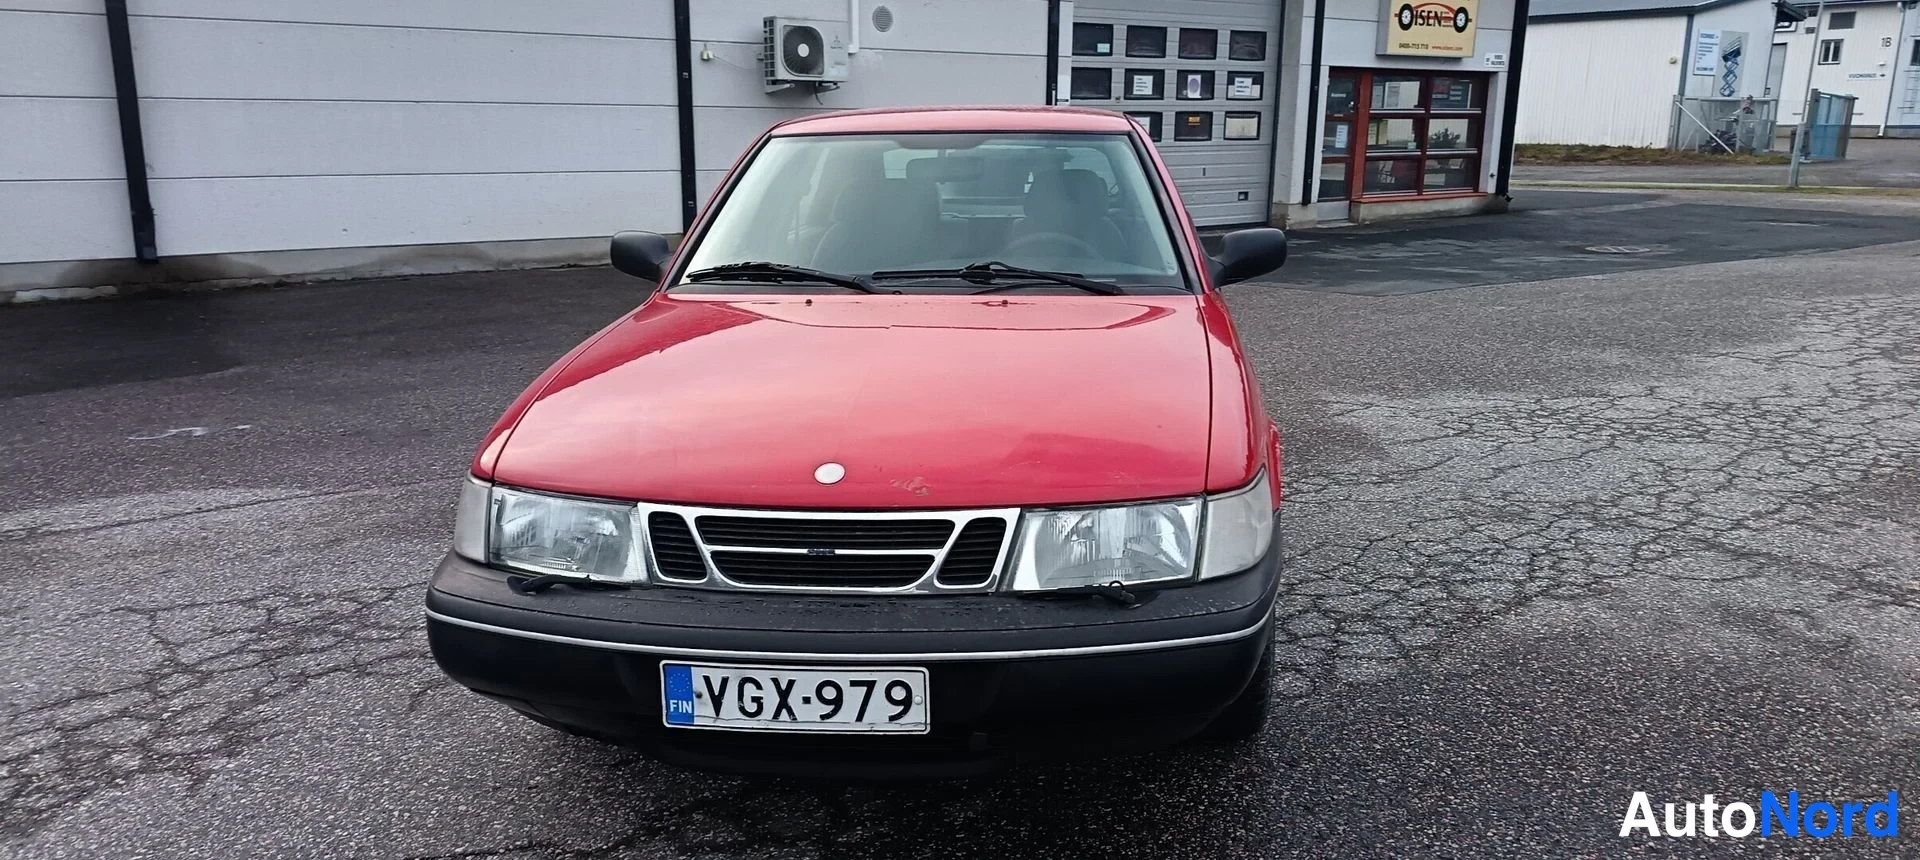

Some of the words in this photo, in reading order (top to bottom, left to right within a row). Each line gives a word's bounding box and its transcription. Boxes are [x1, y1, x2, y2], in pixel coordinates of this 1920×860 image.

[1881, 37, 1892, 47] 1B
[702, 675, 913, 722] VGX-979
[669, 700, 692, 713] FIN
